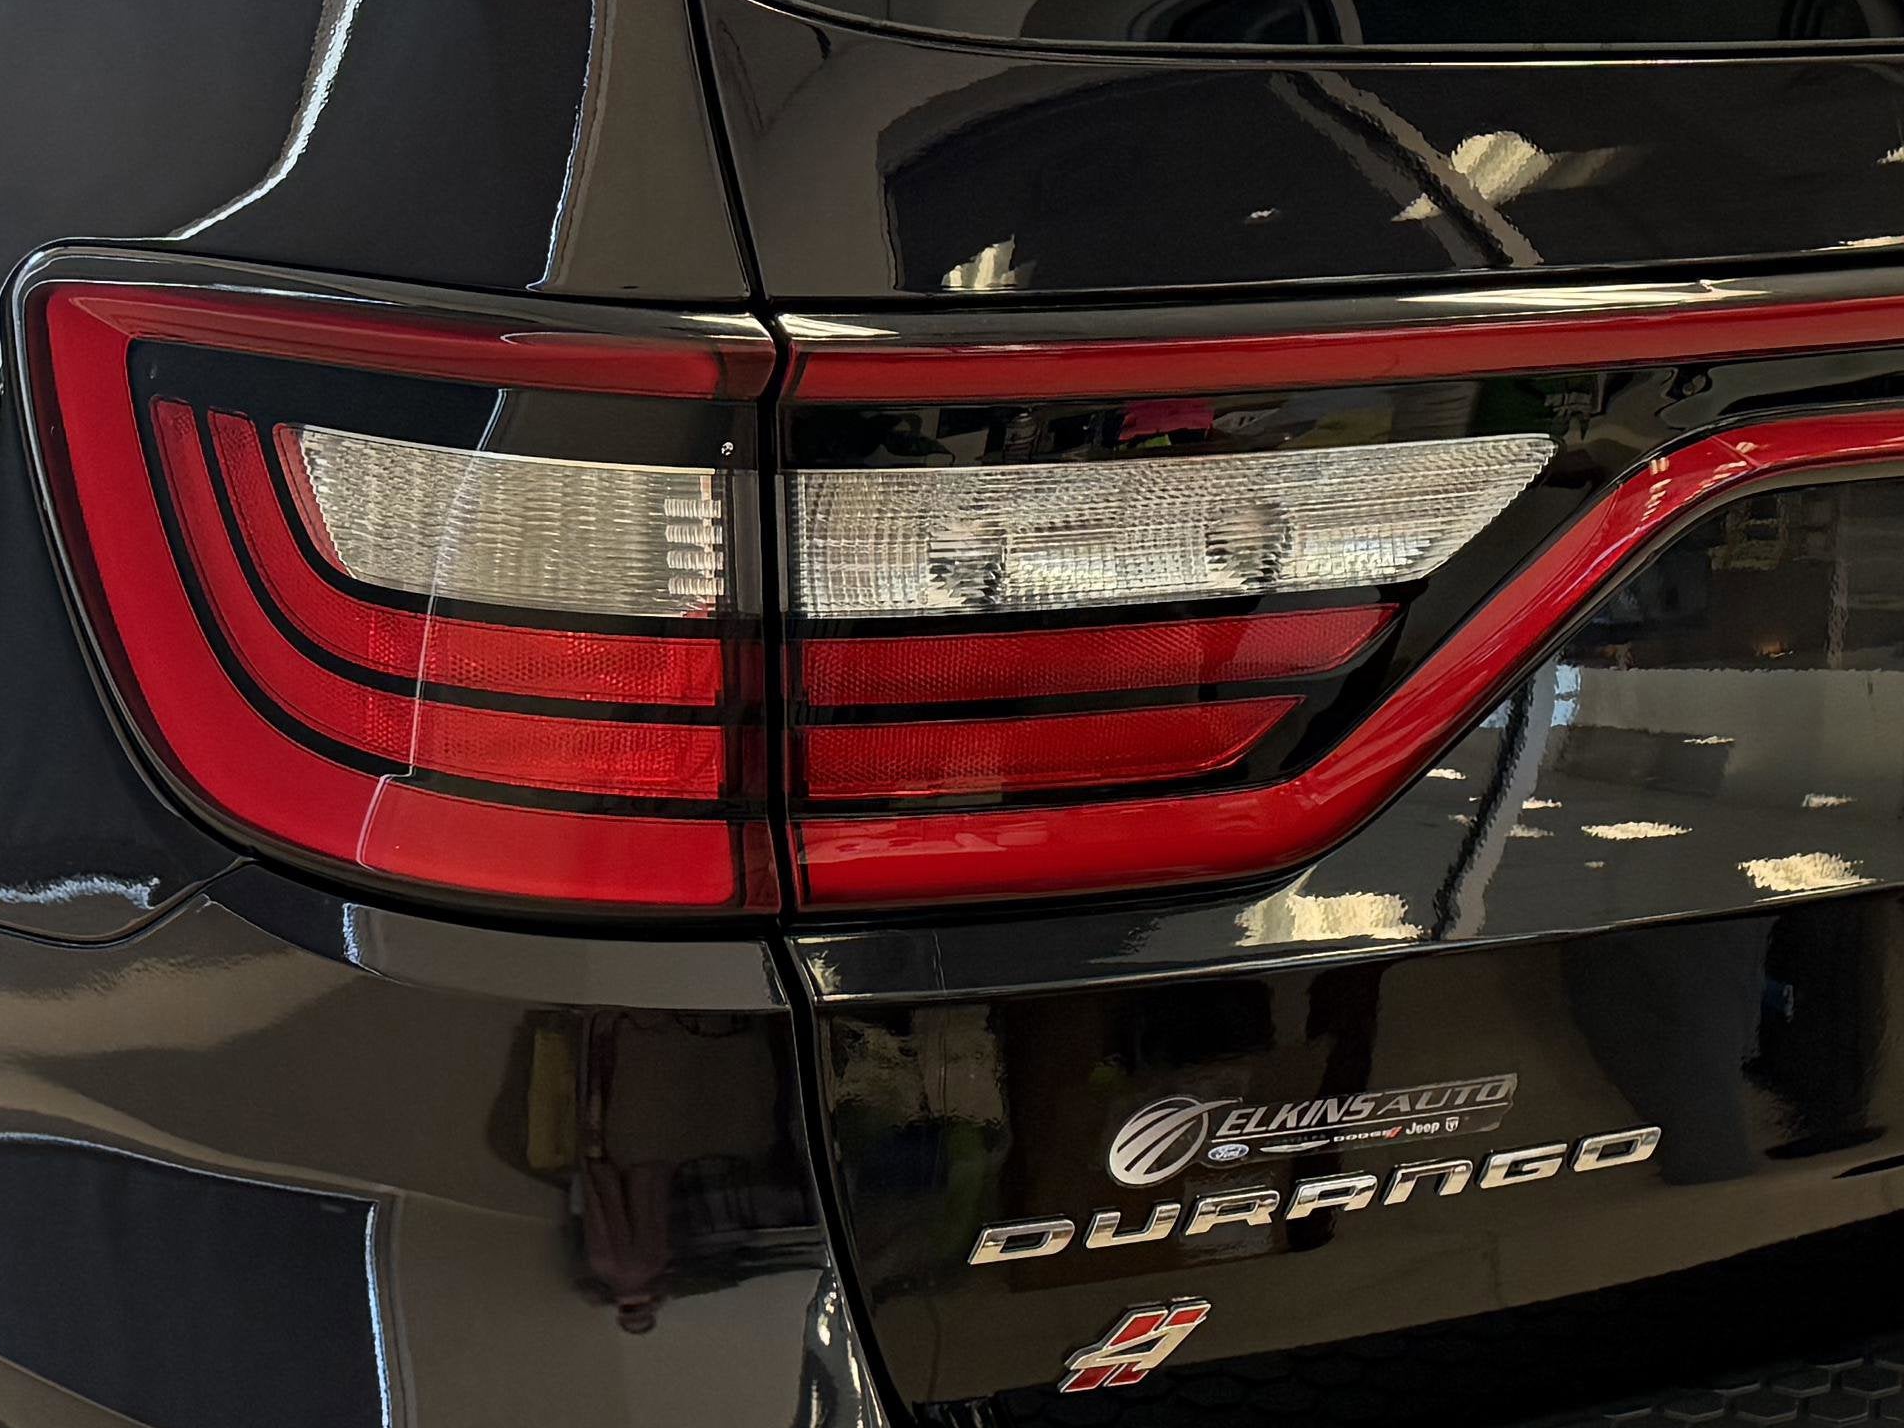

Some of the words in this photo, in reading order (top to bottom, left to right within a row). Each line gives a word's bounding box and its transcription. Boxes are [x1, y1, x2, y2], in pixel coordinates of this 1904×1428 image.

[1215, 1092, 1383, 1137] ELKINS
[1376, 1081, 1512, 1115] AUTO
[1405, 1122, 1440, 1135] Jeep
[967, 1125, 1662, 1265] DURANGO
